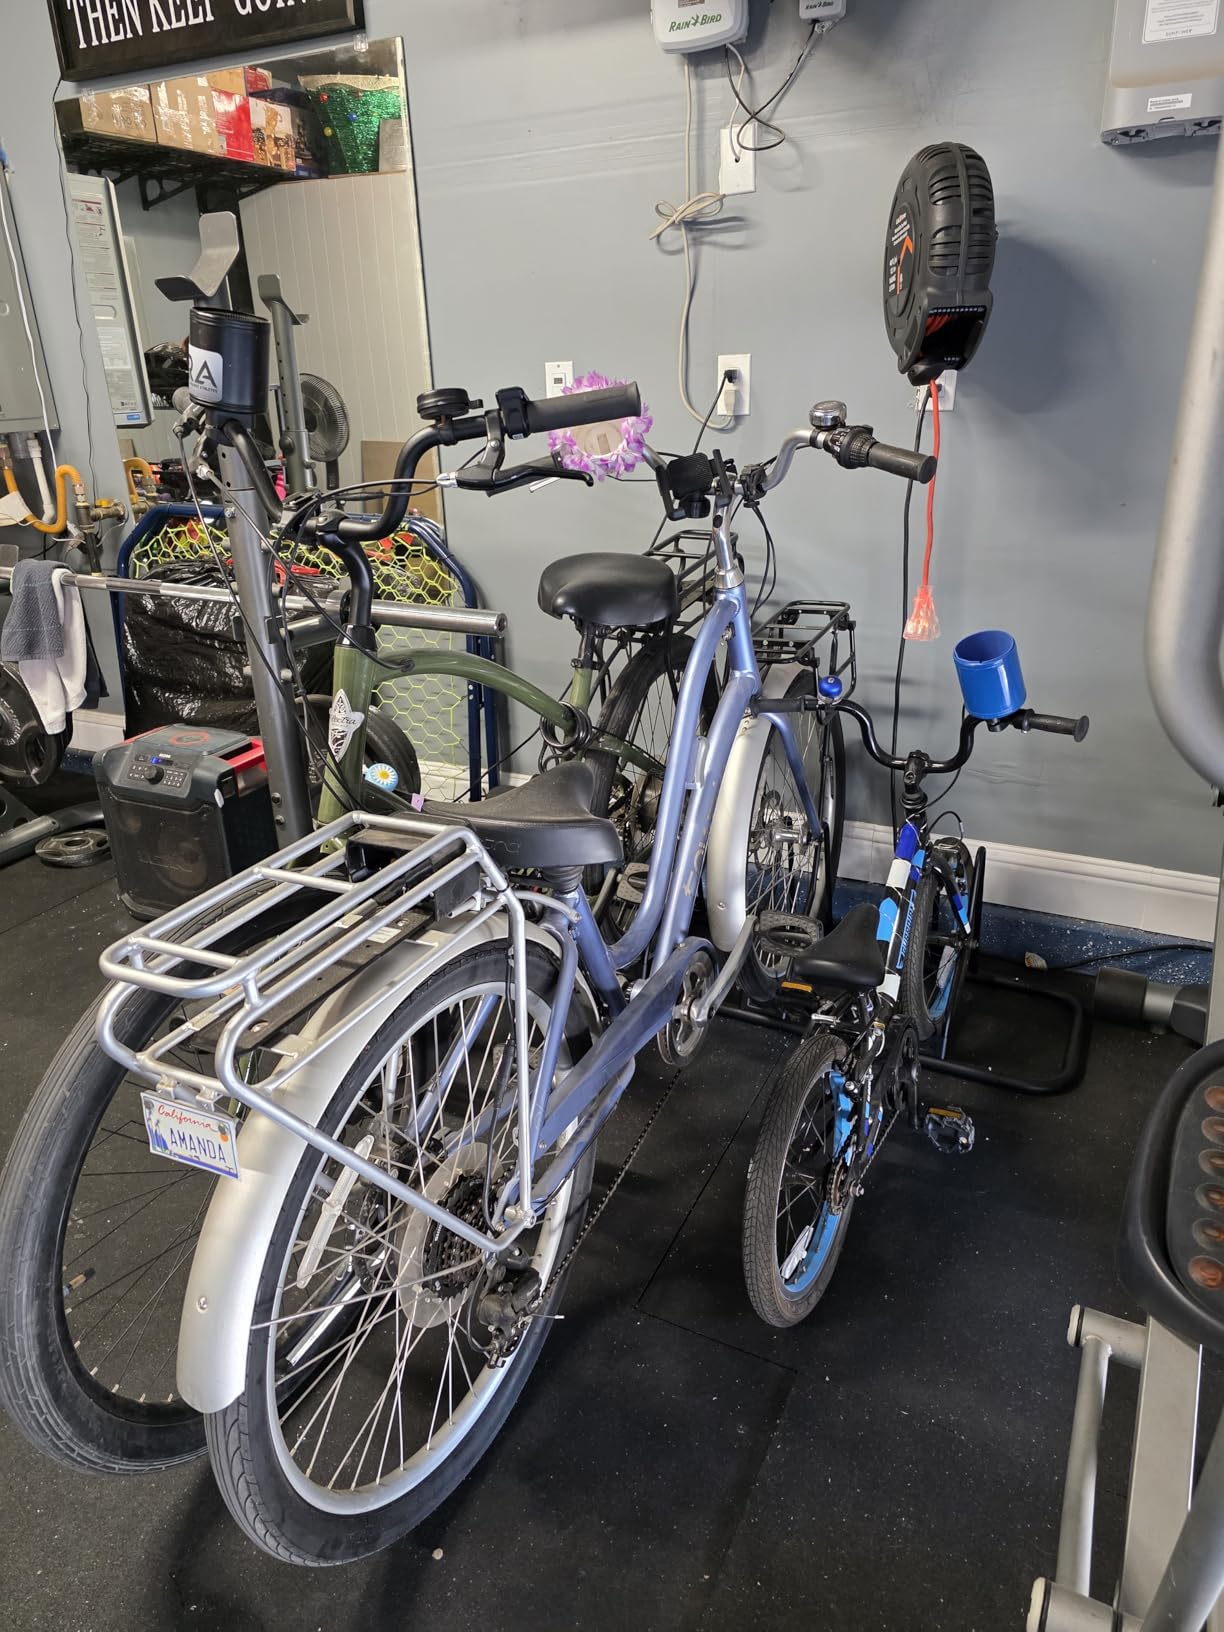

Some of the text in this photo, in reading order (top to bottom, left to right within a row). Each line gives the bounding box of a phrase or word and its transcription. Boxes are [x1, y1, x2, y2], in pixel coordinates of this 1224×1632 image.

[67, 0, 143, 49] THEN
[668, 13, 723, 33] RAIN BIRD
[157, 1104, 214, 1130] California
[169, 1127, 227, 1164] AMANDA
